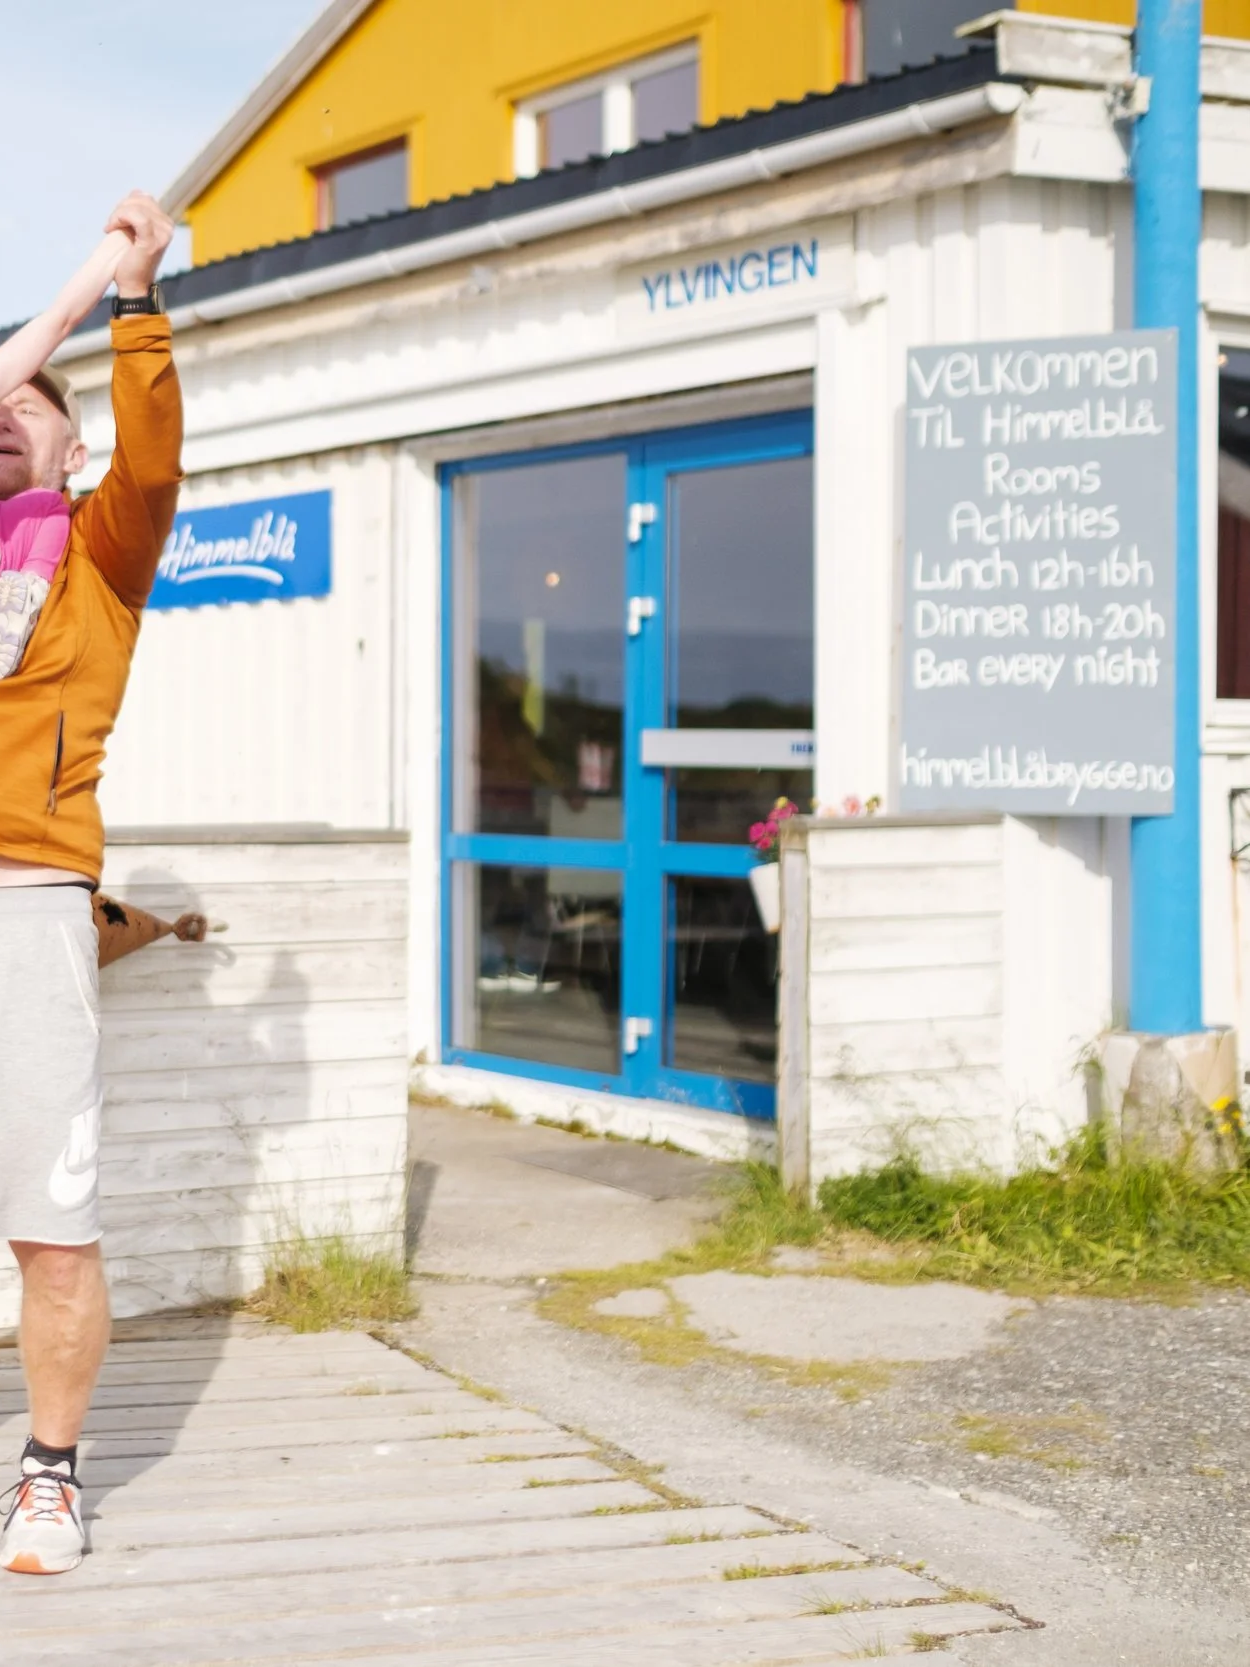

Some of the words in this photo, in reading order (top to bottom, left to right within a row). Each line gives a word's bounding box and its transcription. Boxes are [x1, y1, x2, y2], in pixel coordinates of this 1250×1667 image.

[642, 238, 818, 311] YLVINGEN
[983, 452, 1102, 496] Rooms
[949, 499, 1121, 544] Activities
[913, 547, 1019, 591] Lunch
